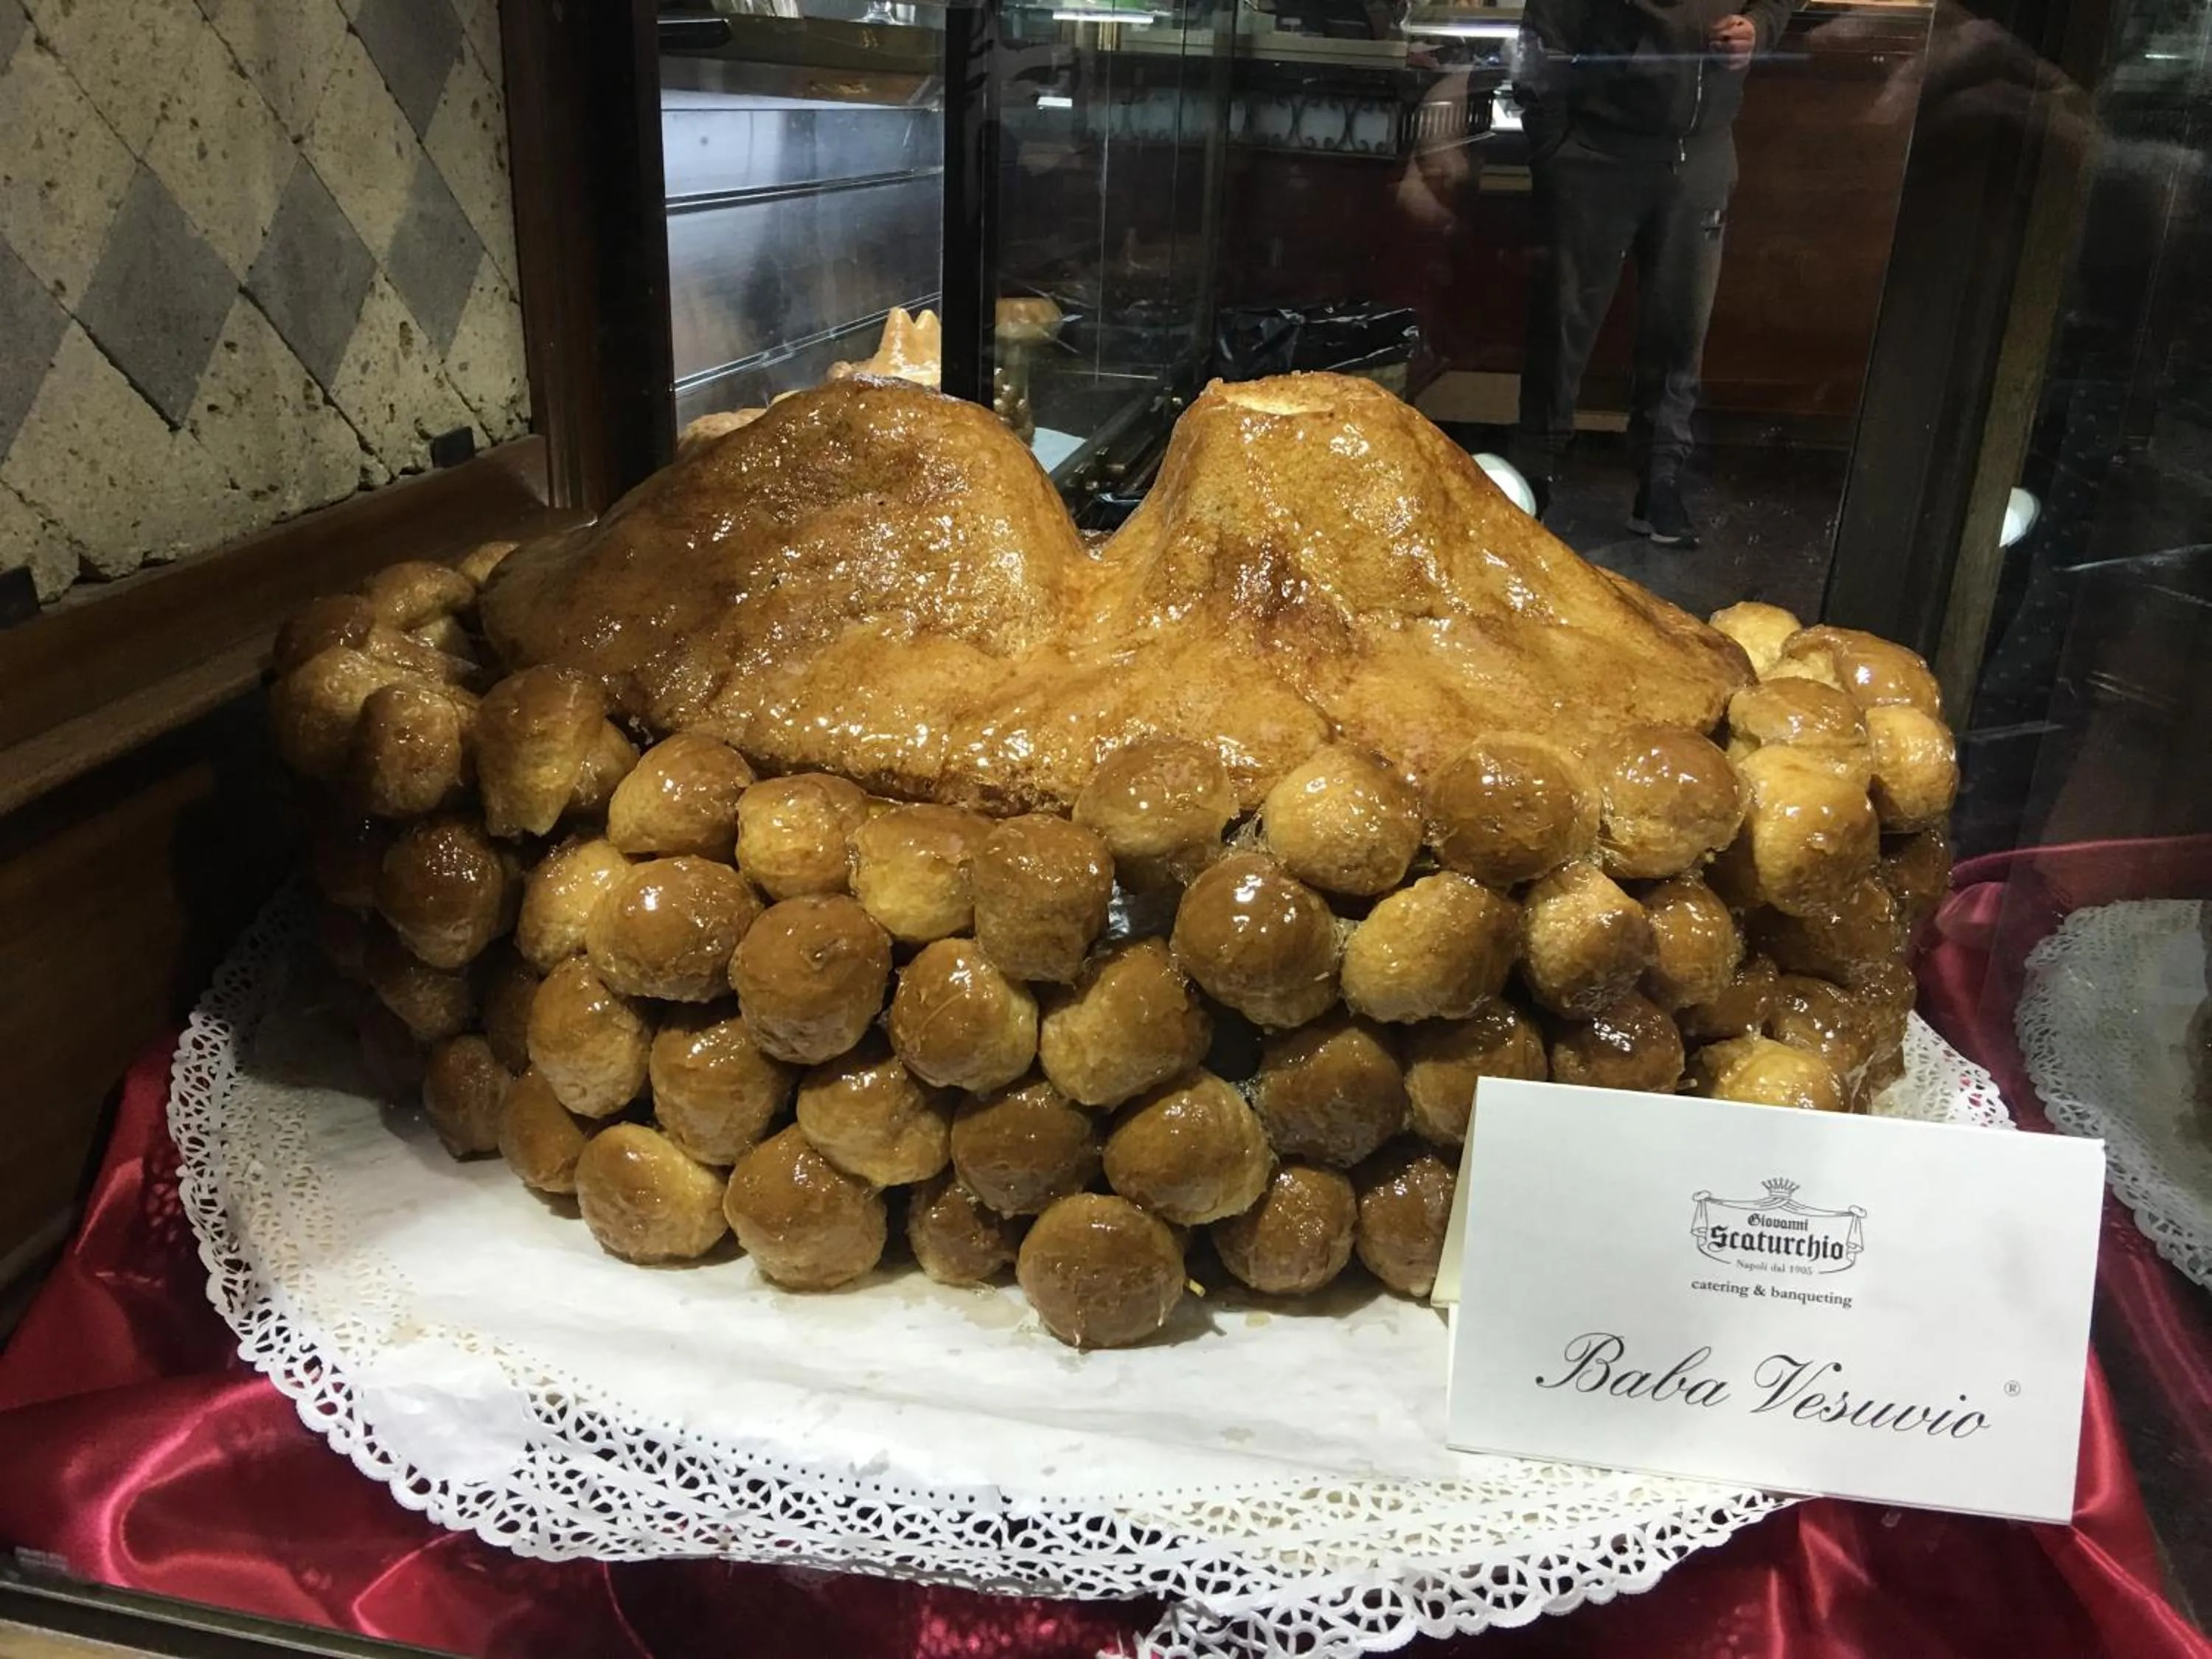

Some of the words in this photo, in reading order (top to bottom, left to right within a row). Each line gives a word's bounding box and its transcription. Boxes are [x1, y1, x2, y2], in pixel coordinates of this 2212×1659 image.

[1747, 1213, 1809, 1231] Giovanni
[1707, 1225, 1844, 1262] Scaturchio
[1736, 1259, 1767, 1272] Napoli
[1770, 1263, 1786, 1273] dal
[1790, 1265, 1813, 1275] 1905
[1691, 1280, 1750, 1298] catering
[1753, 1284, 1767, 1297] &
[1771, 1286, 1853, 1309] banqueting
[1534, 1332, 1731, 1408] Baba
[1749, 1352, 1992, 1440] Vesuvio
